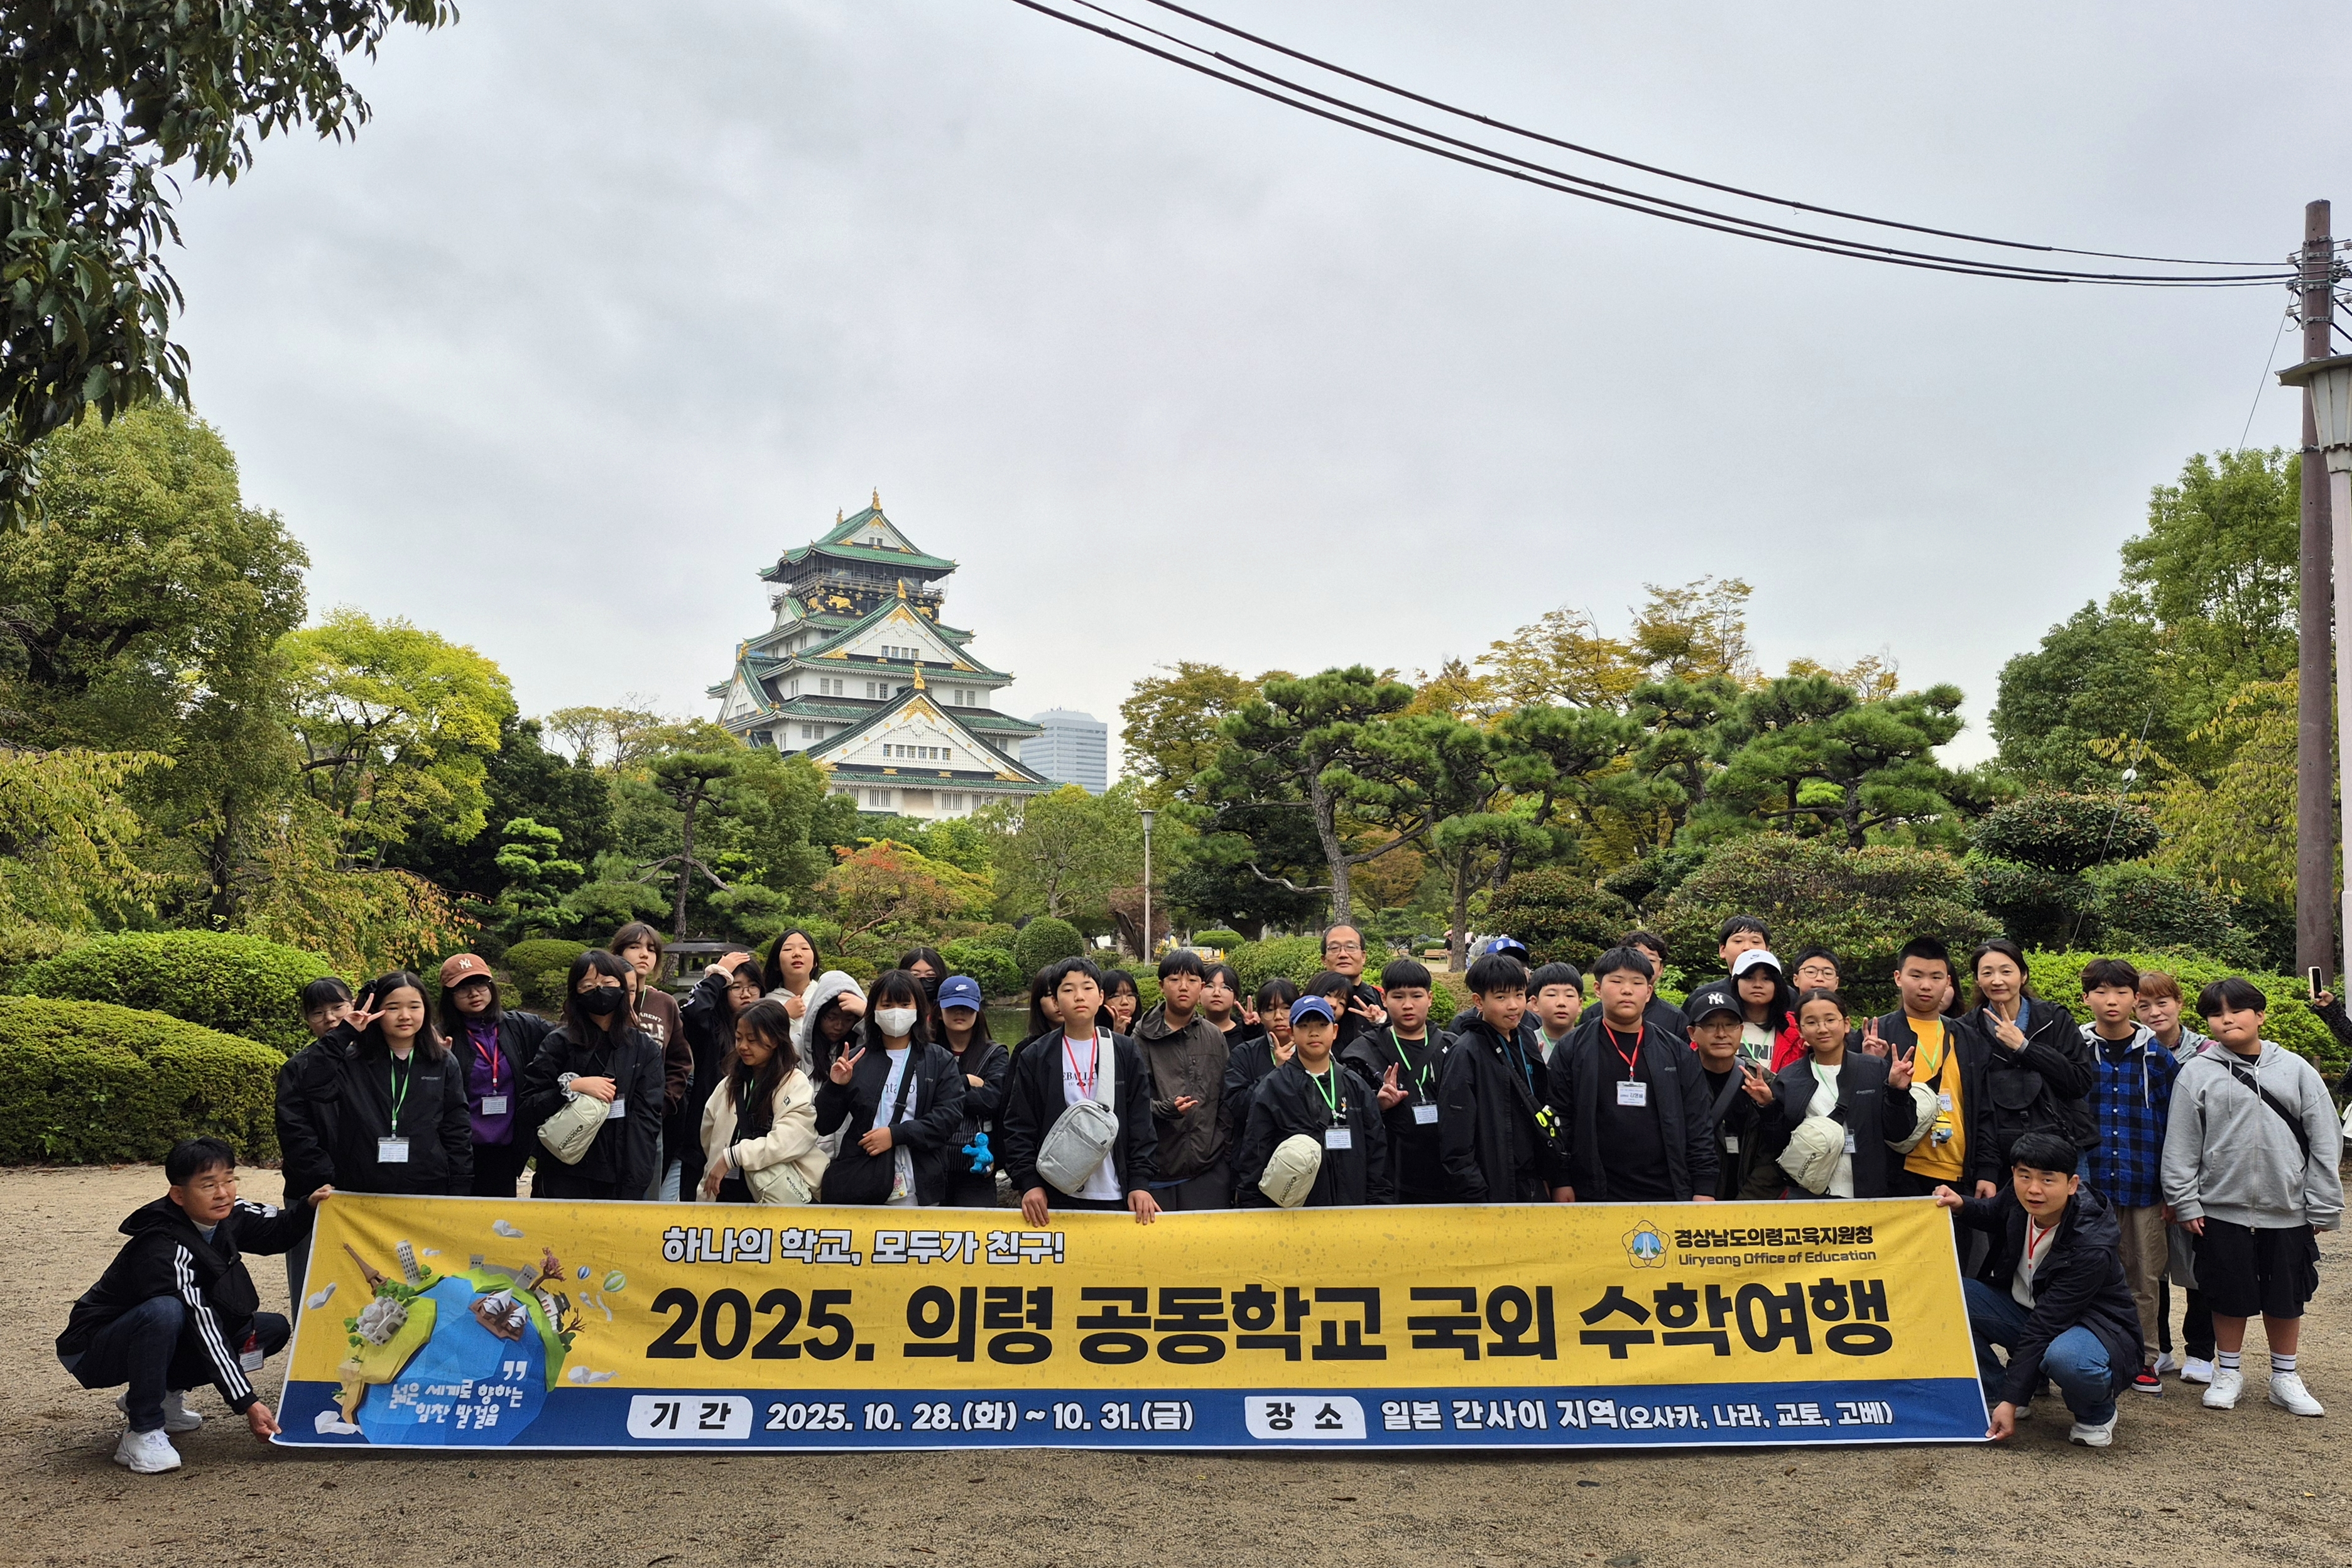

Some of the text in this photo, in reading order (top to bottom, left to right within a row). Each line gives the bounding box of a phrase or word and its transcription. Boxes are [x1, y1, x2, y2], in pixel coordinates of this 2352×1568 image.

[1707, 993, 1724, 1004] NY
[662, 1226, 1065, 1266] 하나의 학교, 모두가 친구!
[1674, 1226, 1875, 1248] 경상남도의령교육지원청
[1678, 1250, 1877, 1267] Uiryeong Office of Education
[646, 1277, 1893, 1365] 2025. 의령 공동학교 국외 수학여행
[388, 1379, 524, 1410] 넓은 세계로 향하는
[415, 1402, 500, 1430] 힘찬 발걸음
[765, 1403, 854, 1431] 2025.
[864, 1403, 902, 1431] 10.
[911, 1401, 1017, 1432] 28.(화)
[1052, 1402, 1092, 1430] 10.
[1100, 1401, 1194, 1432] 31.(금)
[1381, 1401, 1442, 1430] 일본
[1452, 1400, 1548, 1430] 간사이
[1712, 1403, 1771, 1429] 나라,
[1775, 1402, 1831, 1428] 교토,
[1836, 1400, 1893, 1426] 고베)
